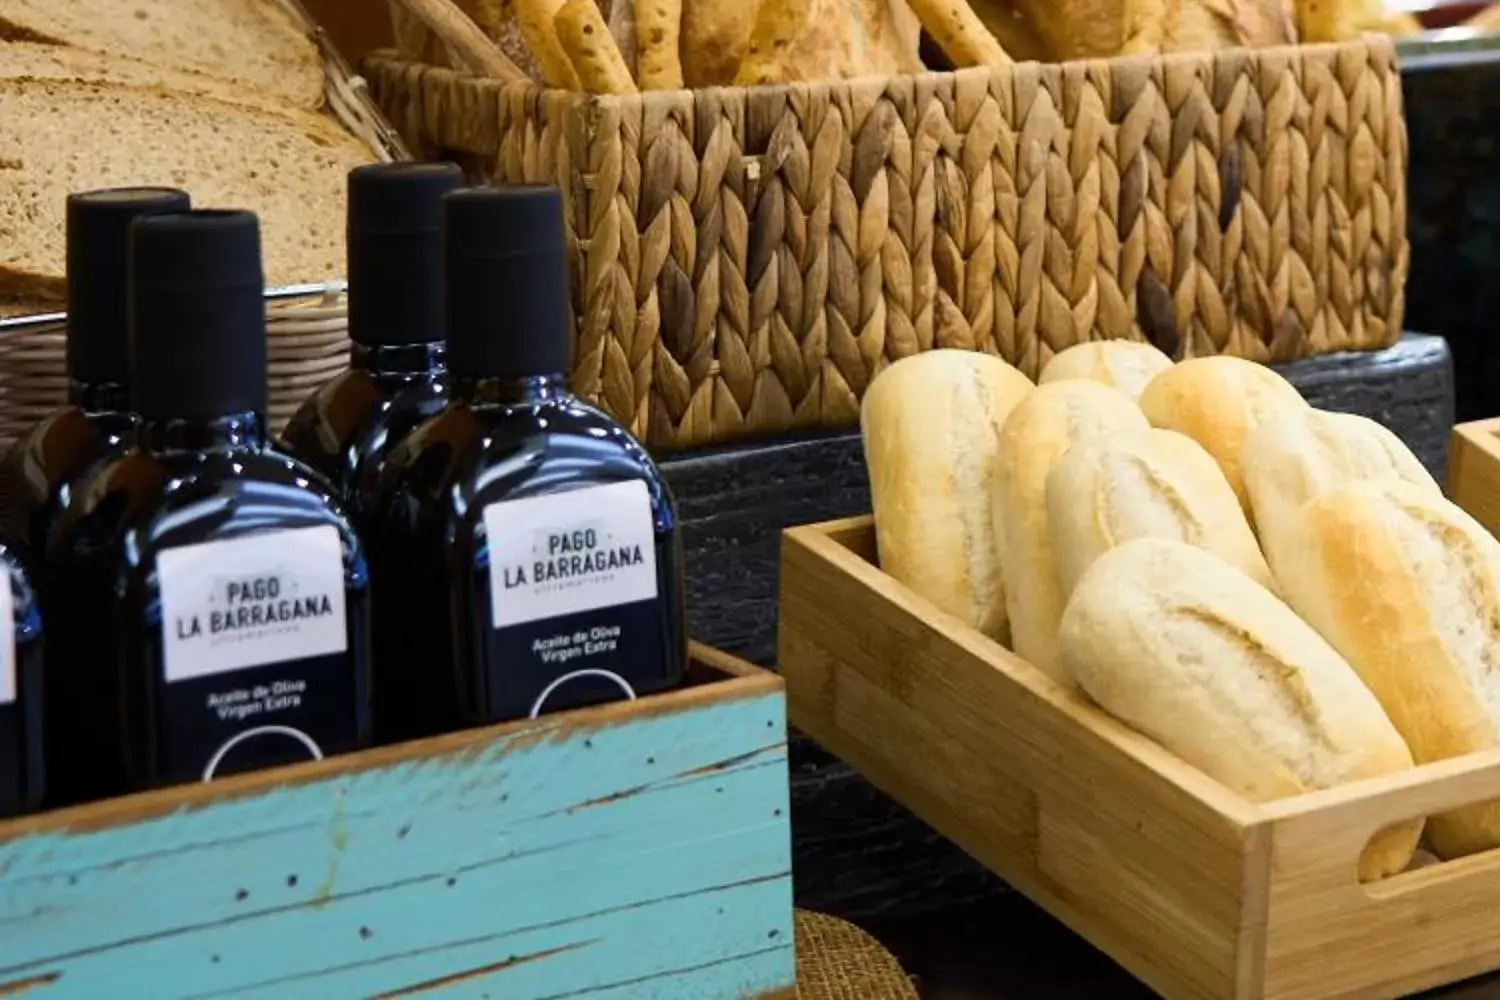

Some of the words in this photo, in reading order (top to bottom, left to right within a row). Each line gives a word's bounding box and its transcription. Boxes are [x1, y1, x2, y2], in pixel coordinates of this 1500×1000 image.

[549, 528, 597, 556] PAGO
[504, 566, 528, 589] LA
[533, 544, 644, 583] BARRAGANA
[227, 577, 280, 604] PAGO
[177, 616, 201, 640] LA
[210, 594, 332, 633] BARRAGANA
[532, 635, 570, 652] Aceite
[541, 647, 581, 663] Virgen
[584, 640, 617, 655] Extra
